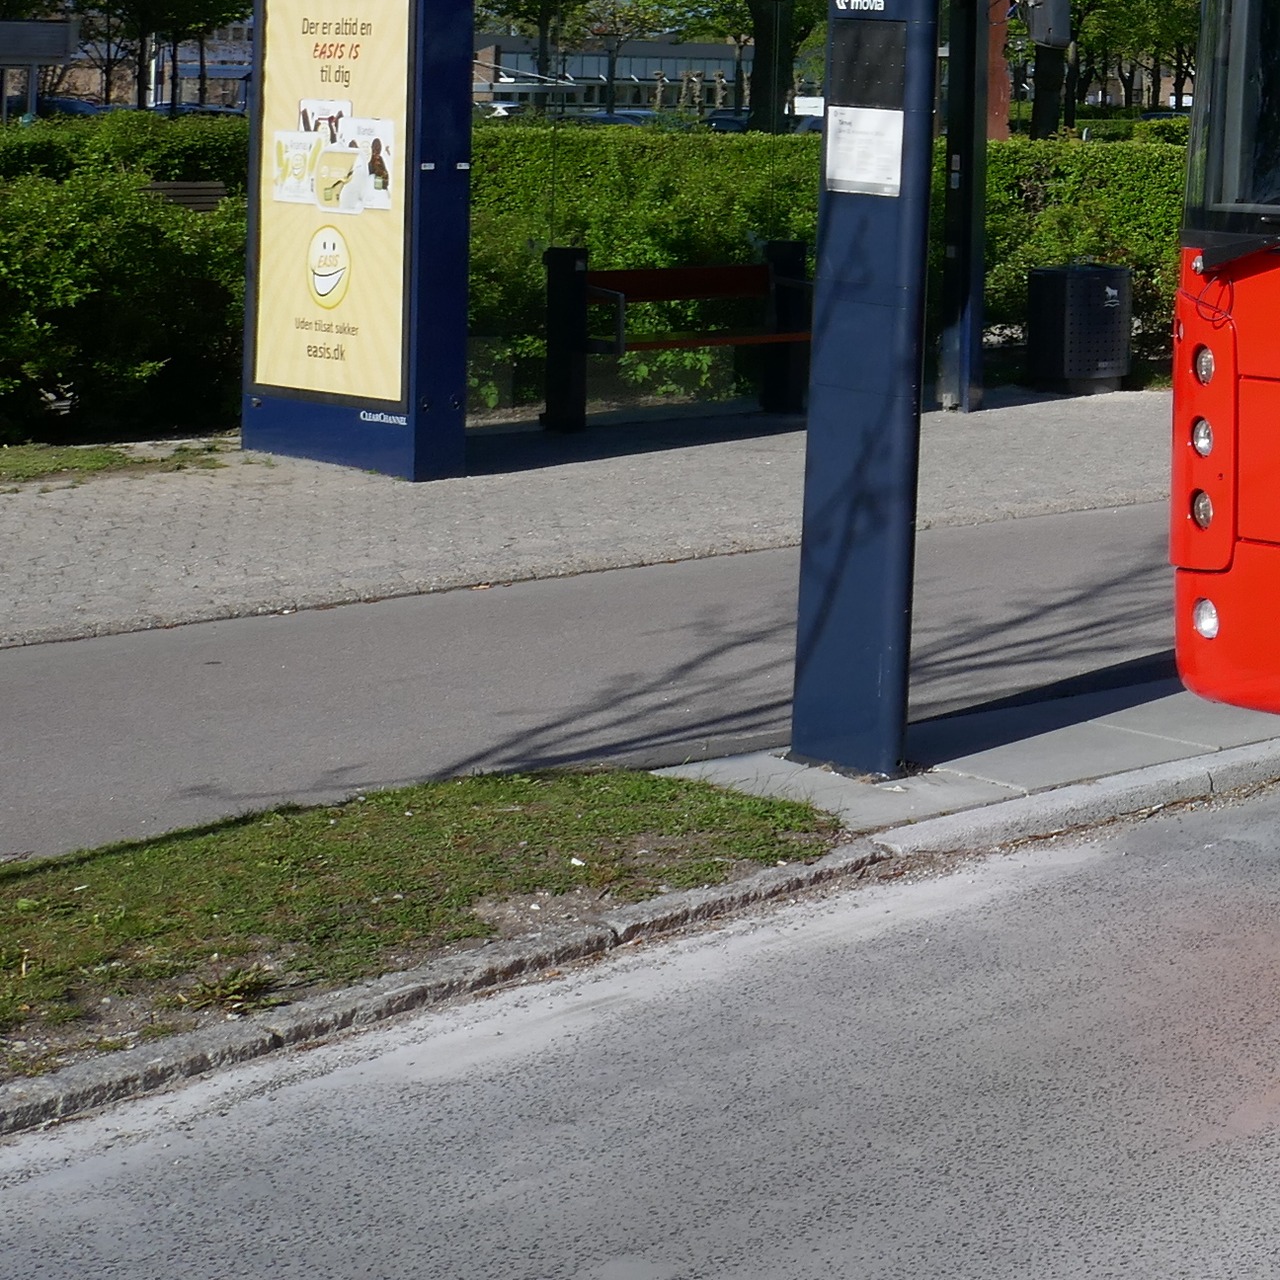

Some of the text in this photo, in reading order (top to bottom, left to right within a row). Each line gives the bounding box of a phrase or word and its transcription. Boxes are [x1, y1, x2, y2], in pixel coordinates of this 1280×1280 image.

[301, 17, 372, 36] Der er altid en
[313, 42, 360, 60] EASIS IS
[320, 65, 351, 88] til dig
[294, 317, 313, 331] Uden
[306, 342, 346, 361] easis.dk
